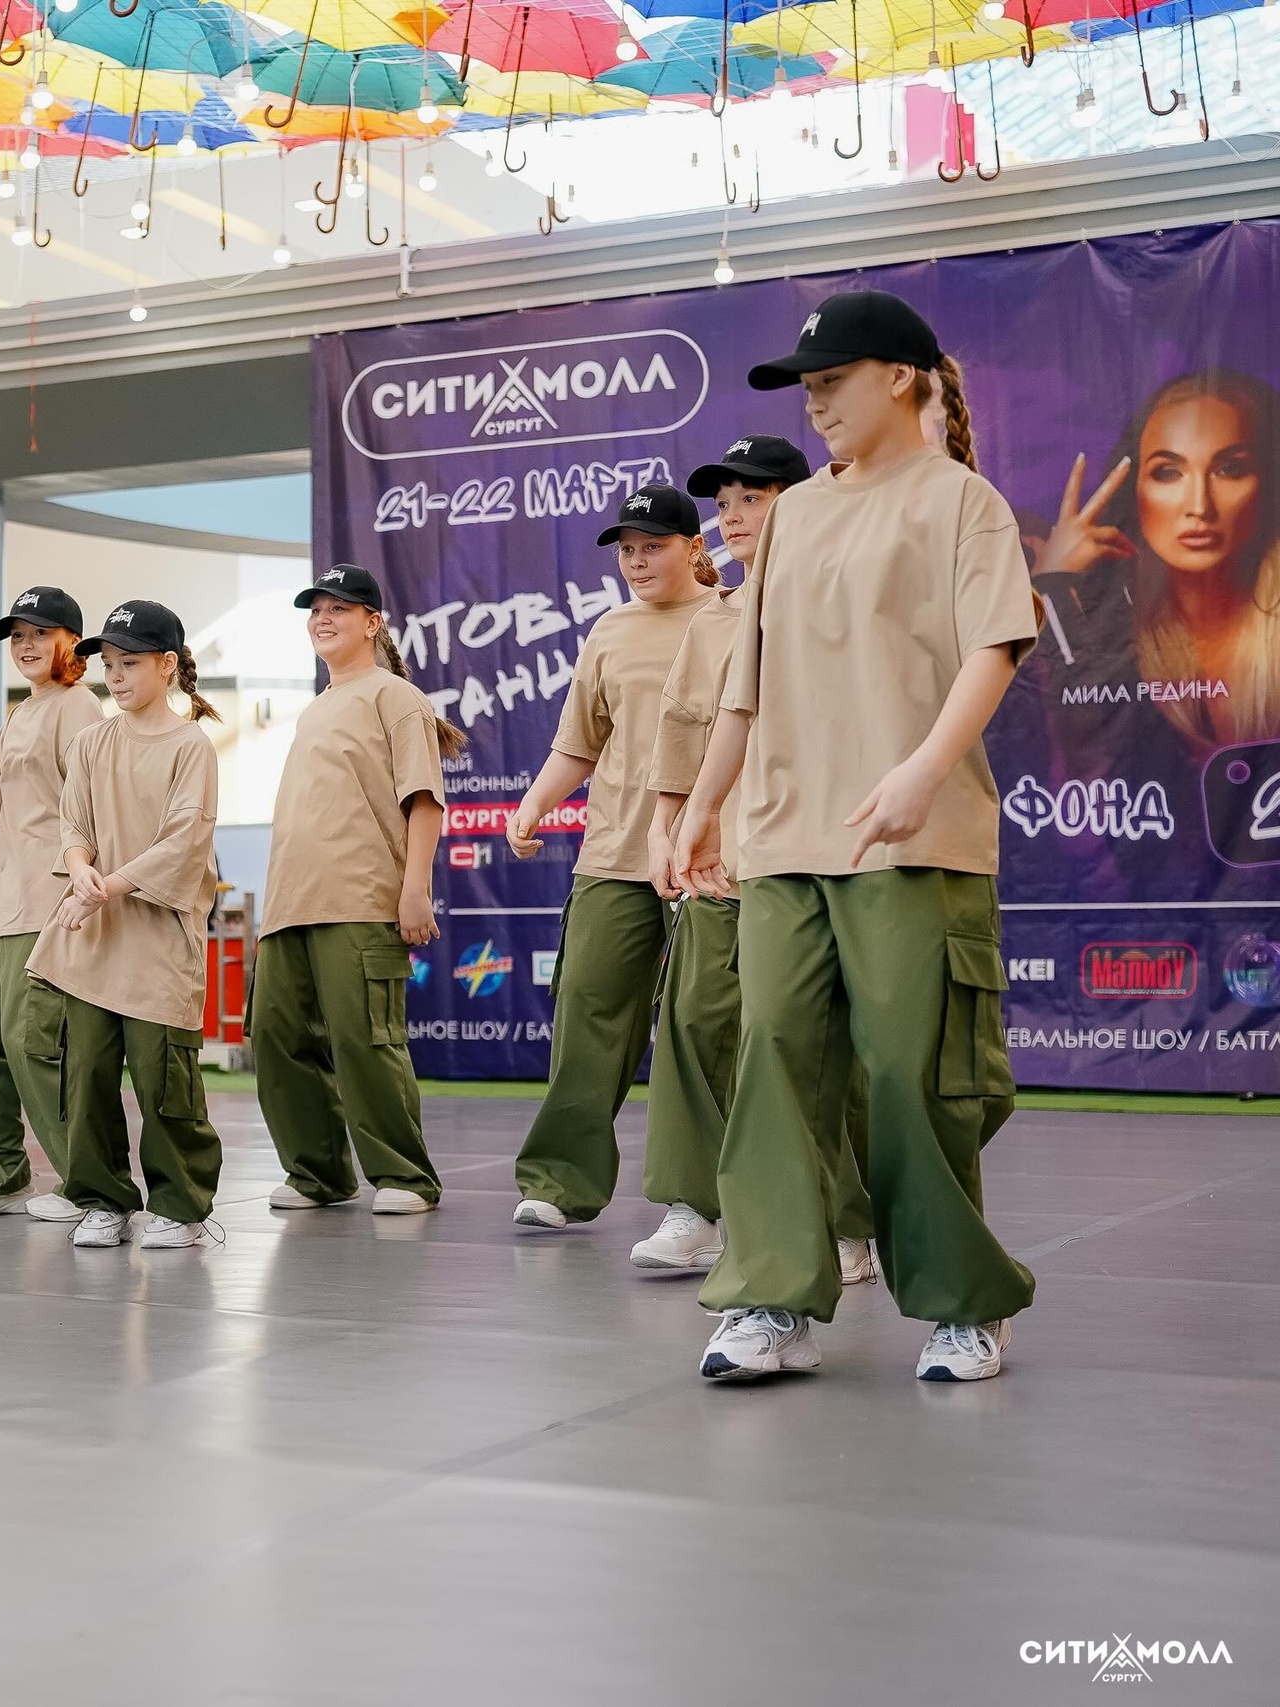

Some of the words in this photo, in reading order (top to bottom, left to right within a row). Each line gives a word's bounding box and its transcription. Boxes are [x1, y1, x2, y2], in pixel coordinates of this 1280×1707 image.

[484, 416, 544, 437] СУРГУТ
[373, 476, 517, 533] 21-22
[524, 456, 674, 519] МАРТА
[1061, 683, 1131, 705] МИЛА
[1136, 679, 1229, 702] РЕДИНА
[1002, 774, 1174, 841] ФОНД
[461, 1019, 509, 1041] ШОУ
[1003, 1026, 1127, 1050] ЕВАЛЬНОЕ
[1133, 1028, 1192, 1051] ШОУ
[1198, 1029, 1210, 1053] /
